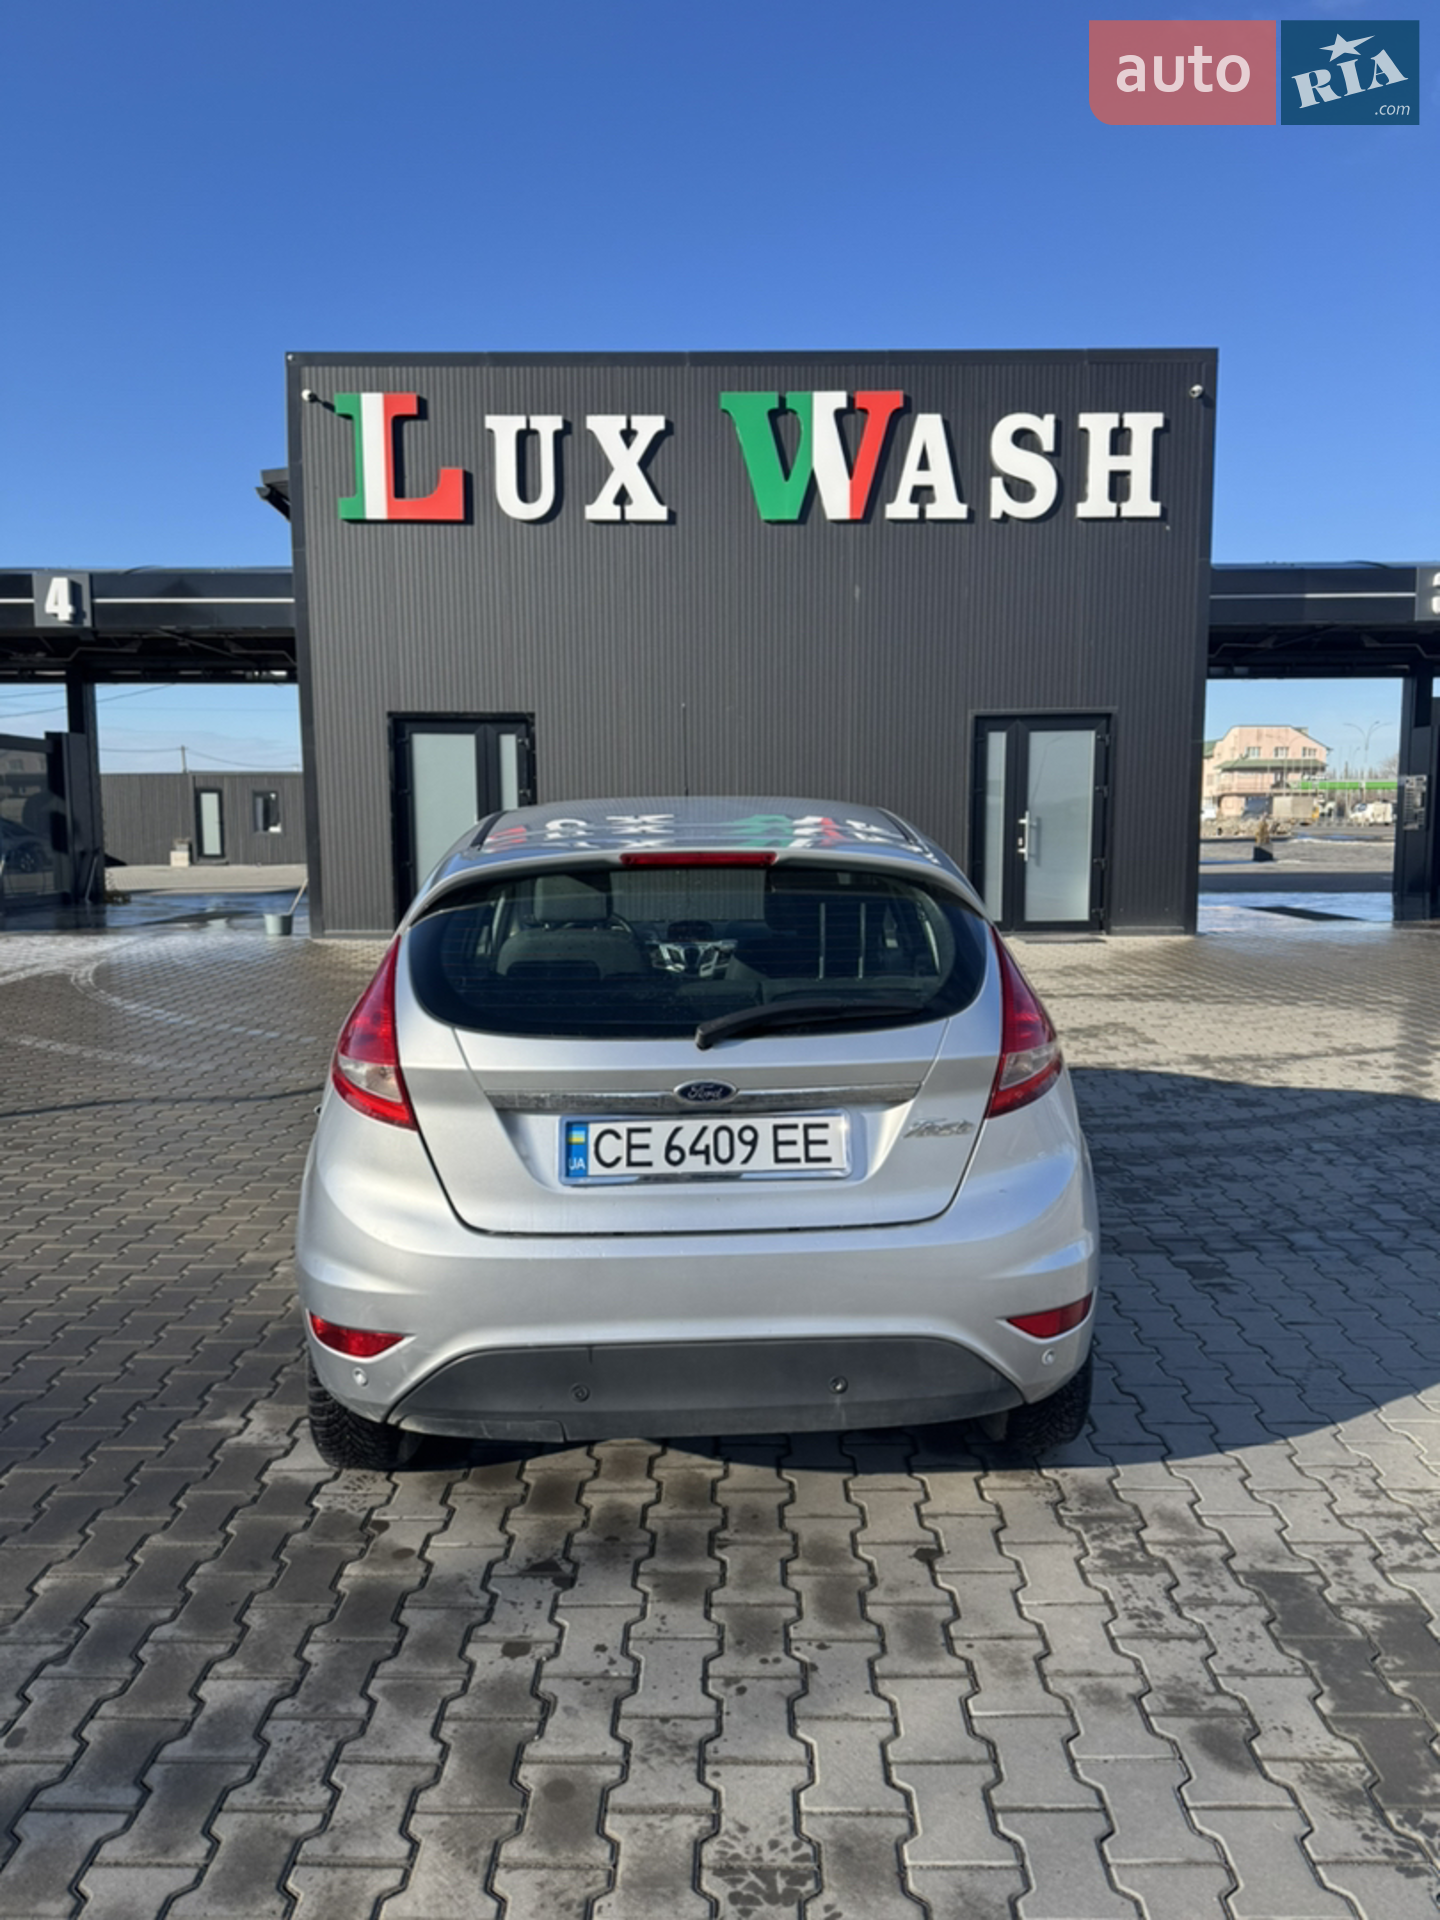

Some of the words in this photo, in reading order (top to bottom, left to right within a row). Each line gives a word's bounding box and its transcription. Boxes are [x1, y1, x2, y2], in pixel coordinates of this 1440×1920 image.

[334, 391, 669, 521] LUX
[719, 390, 1165, 521] WASH
[45, 577, 73, 621] 4
[687, 1085, 723, 1101] Ford
[568, 1157, 586, 1171] UA
[593, 1127, 653, 1169] CE
[664, 1125, 759, 1168] 6409
[772, 1122, 832, 1165] EE
